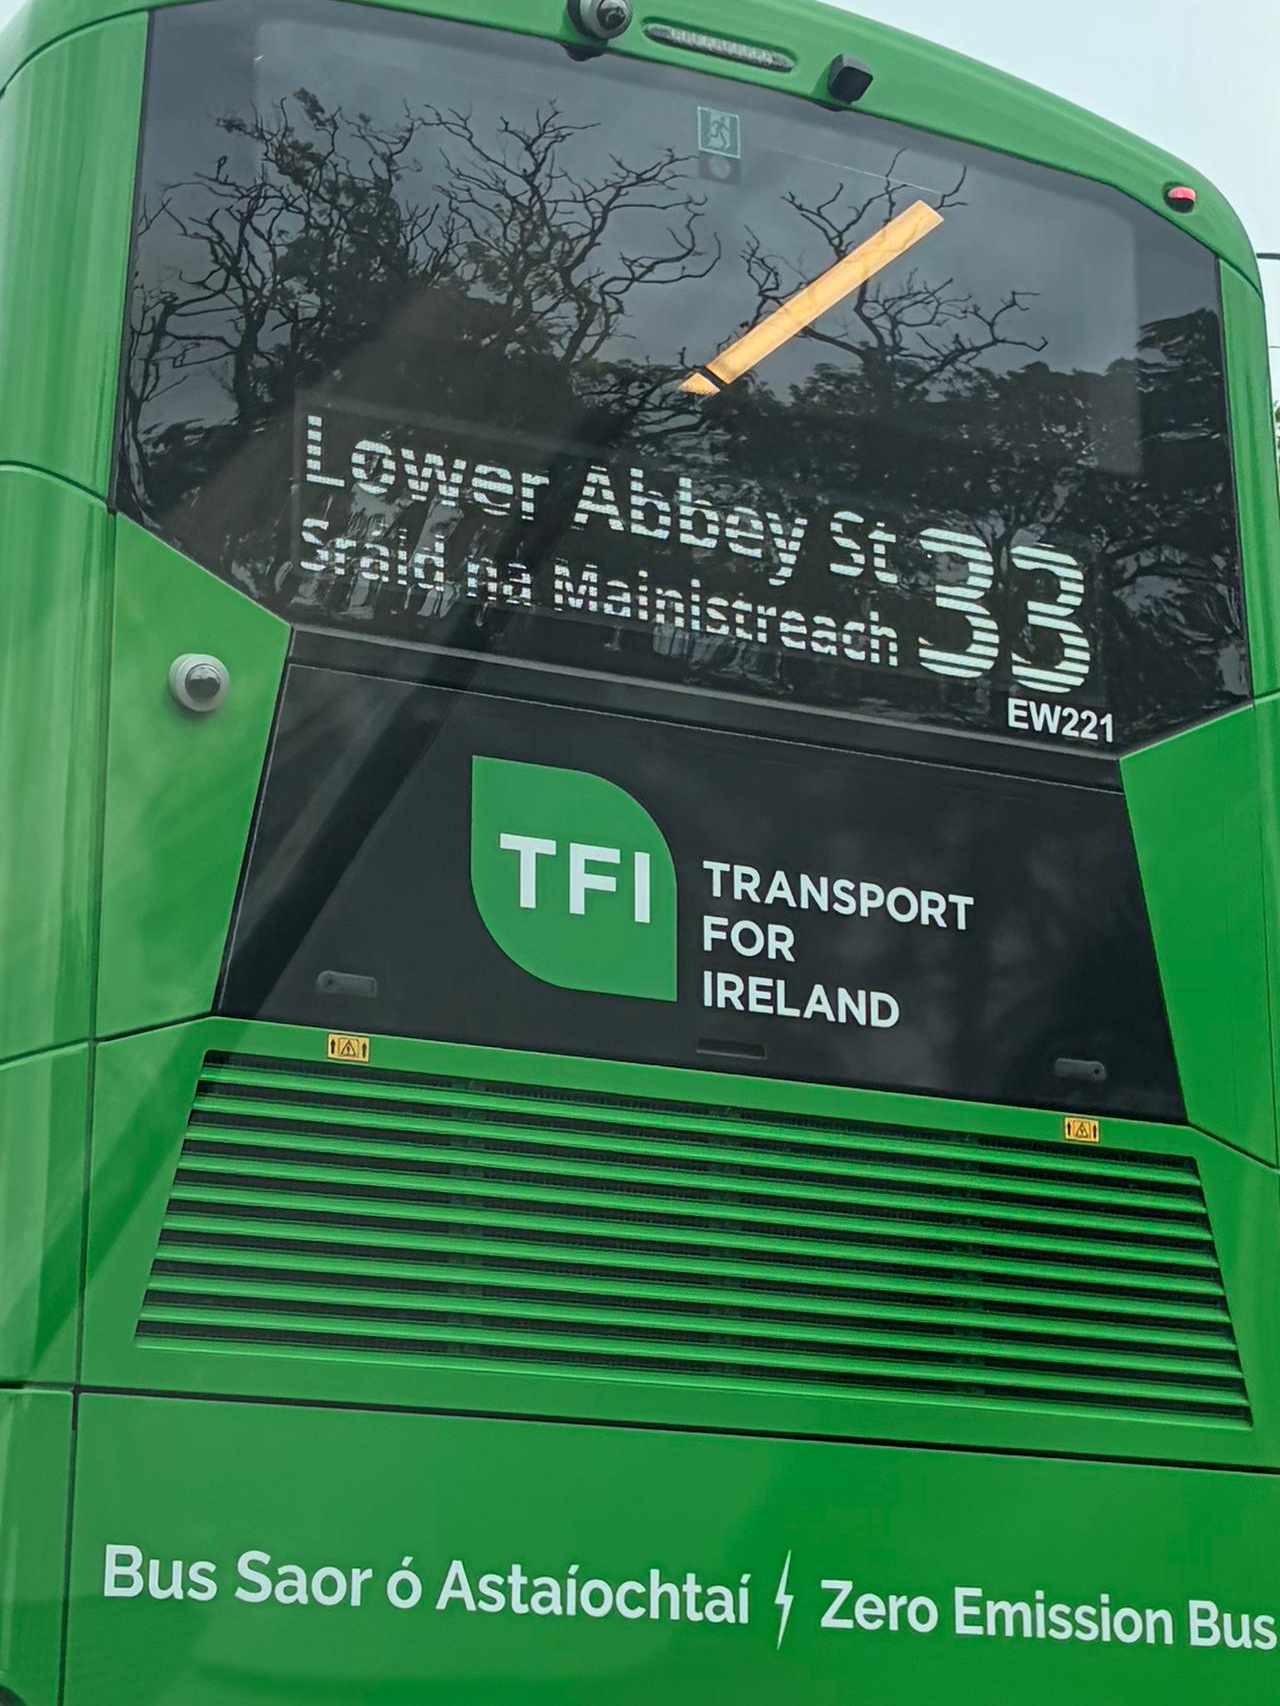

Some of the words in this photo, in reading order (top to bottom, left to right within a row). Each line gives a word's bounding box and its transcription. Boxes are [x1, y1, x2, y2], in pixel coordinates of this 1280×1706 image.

[306, 415, 550, 521] Lower
[571, 465, 808, 586] Abbey
[830, 510, 898, 584] St
[467, 557, 532, 606] na
[919, 526, 1091, 693] 33
[1006, 697, 1114, 743] EW221
[499, 832, 651, 925] TFI
[702, 860, 975, 932] TRANSPORT
[702, 915, 796, 963] FOR
[702, 970, 901, 1030] IRELAND
[103, 1543, 218, 1601] Bus
[235, 1549, 373, 1607] Saor
[386, 1556, 422, 1609] ó
[435, 1559, 751, 1624] Astaíochtaí
[820, 1579, 938, 1633] Zero
[954, 1586, 1174, 1645] Emission
[1189, 1599, 1279, 1651] Bus
